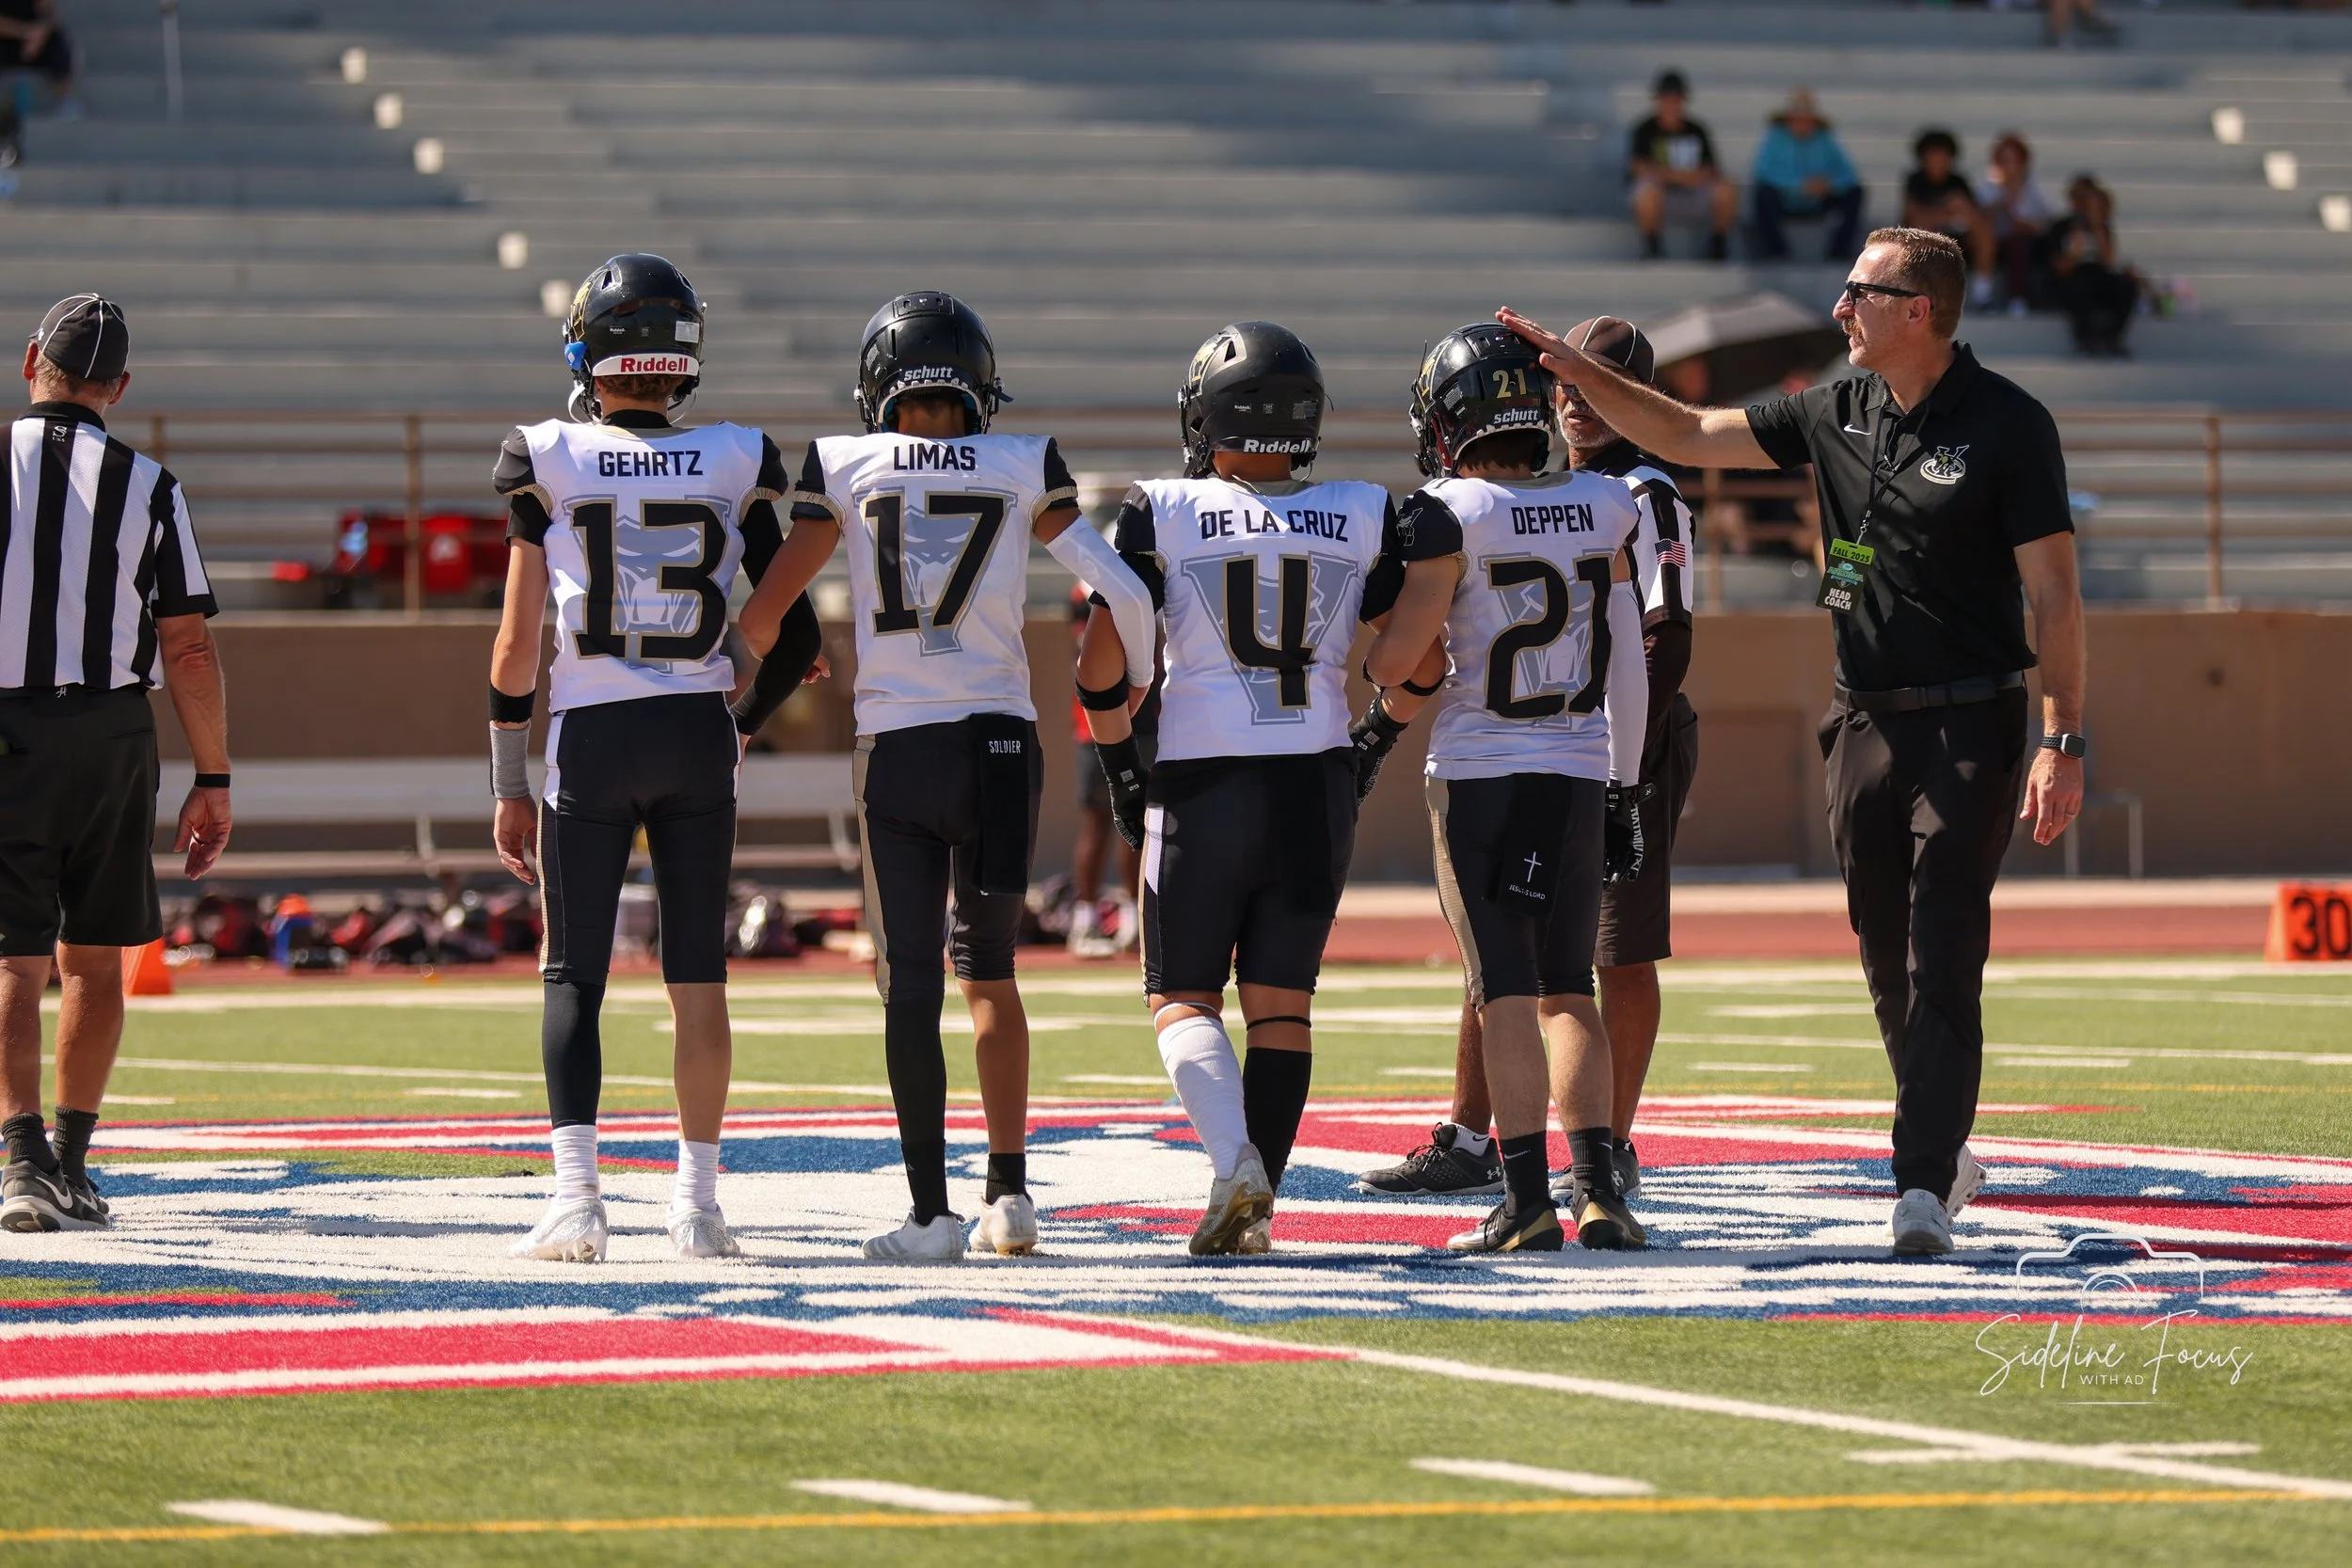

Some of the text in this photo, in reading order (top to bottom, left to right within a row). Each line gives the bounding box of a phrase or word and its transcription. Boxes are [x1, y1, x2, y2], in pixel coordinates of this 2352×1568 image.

[620, 357, 689, 372] Riddell
[903, 364, 954, 382] schutt
[1492, 368, 1528, 399] 21
[1493, 407, 1539, 424] schutt
[894, 443, 977, 471] LIMAS
[1243, 438, 1311, 453] Riddell
[598, 450, 704, 477] GEHRTZ
[1200, 509, 1349, 543] DE LA CRUZ
[1511, 503, 1596, 535] DEPPEN
[860, 490, 1011, 638] 17
[1833, 546, 1870, 562] FALL 2025
[570, 499, 730, 663] 13
[1829, 587, 1851, 601] HEAD
[1824, 595, 1852, 610] COACH
[1223, 553, 1319, 711] 4
[1484, 553, 1614, 721] 21
[989, 739, 1022, 753] SOLDIER
[2290, 895, 2351, 958] 30
